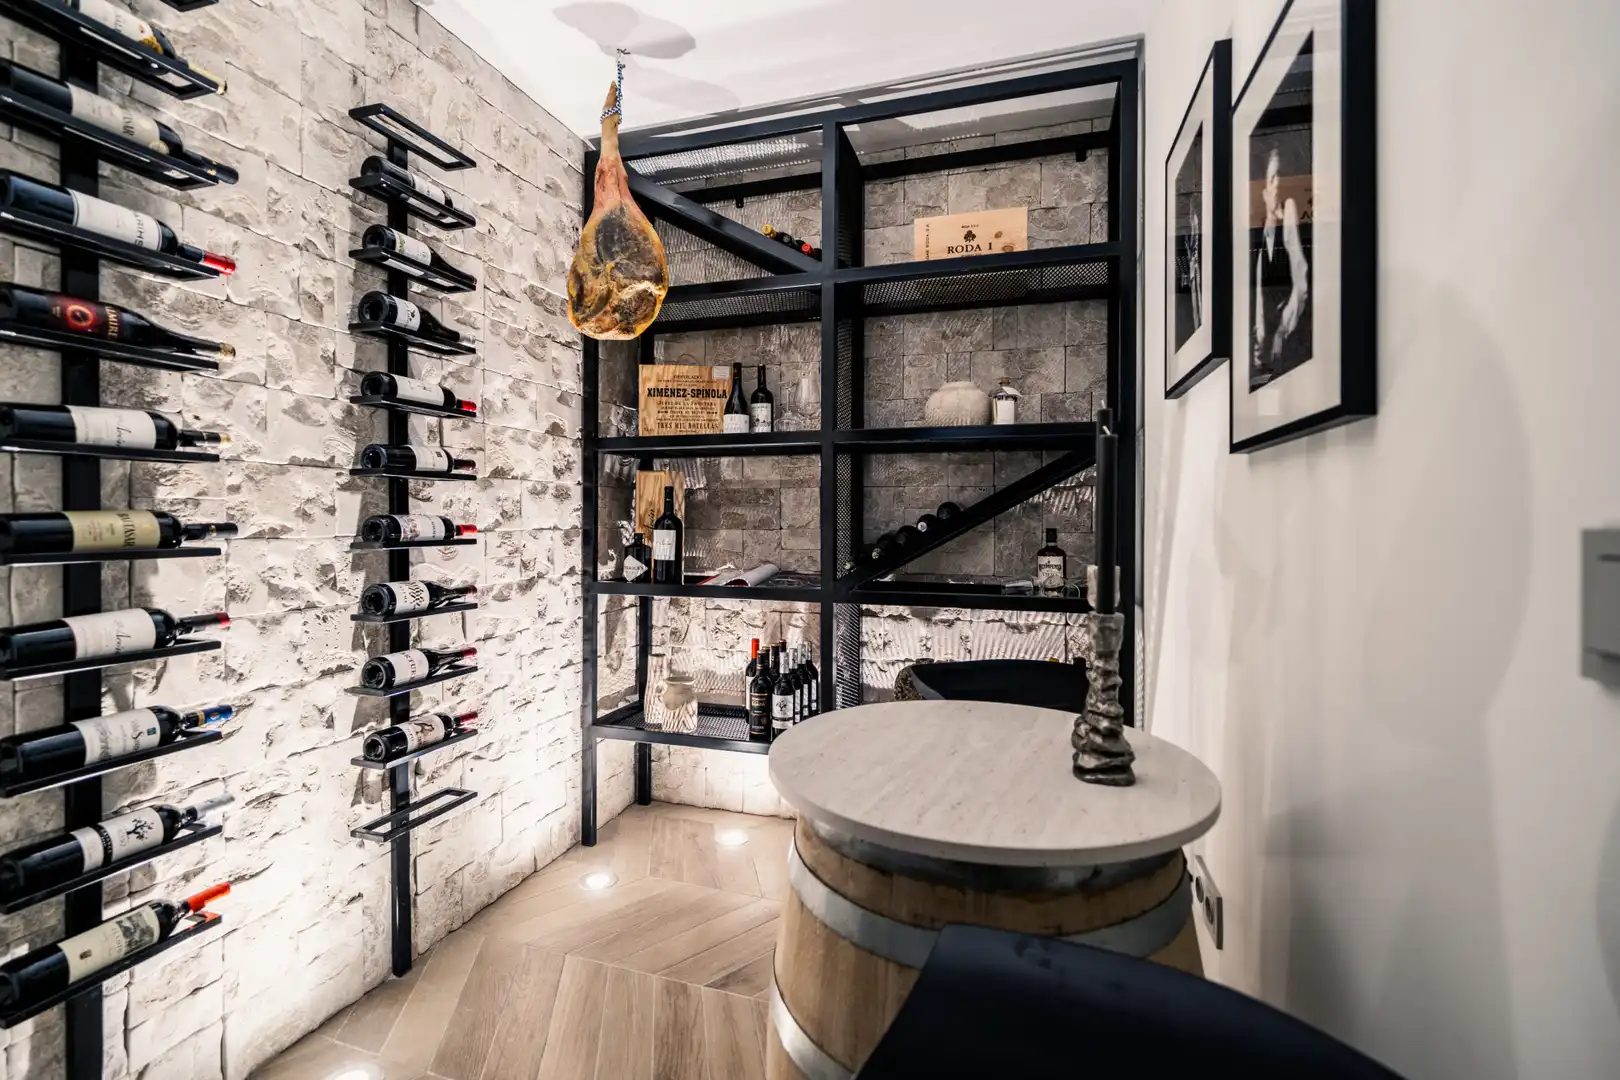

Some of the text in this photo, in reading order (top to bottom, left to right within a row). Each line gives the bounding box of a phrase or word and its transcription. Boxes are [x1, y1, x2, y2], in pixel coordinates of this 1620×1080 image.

[947, 242, 993, 254] RODA I
[647, 384, 727, 399] XIMÉNEZ-SPÍNOLA
